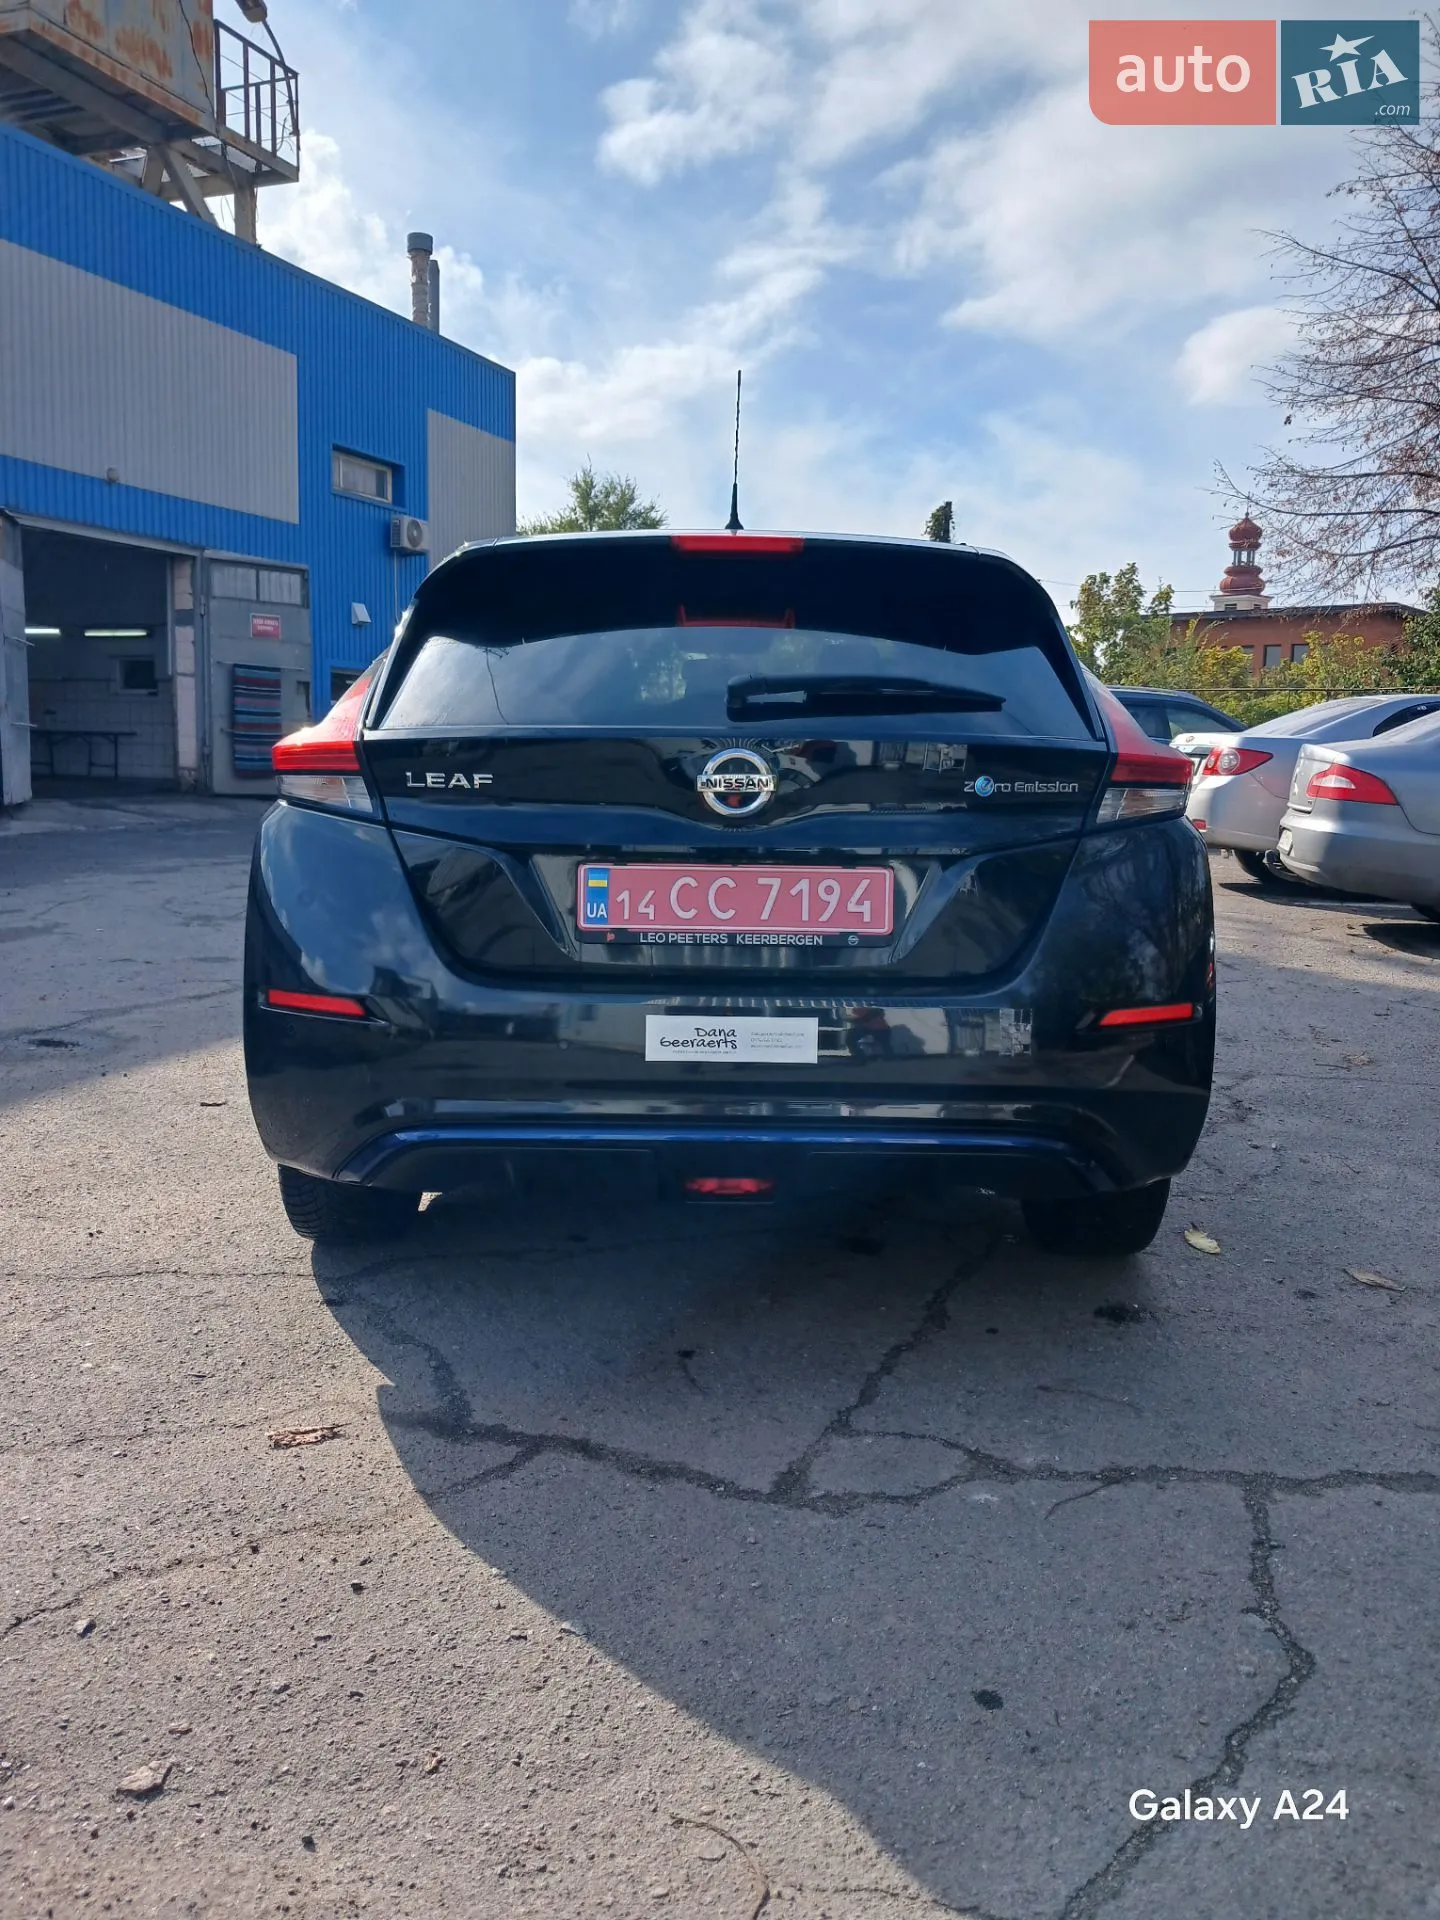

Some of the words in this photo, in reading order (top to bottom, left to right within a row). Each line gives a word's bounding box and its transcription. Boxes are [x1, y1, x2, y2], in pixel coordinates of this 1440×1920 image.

[405, 772, 494, 789] LEAF
[706, 778, 769, 789] NISSAN
[616, 890, 656, 921] 14
[669, 876, 737, 920] CC
[757, 877, 872, 922] 7194
[587, 903, 607, 919] UA
[640, 932, 666, 943] LEO
[668, 932, 728, 945] PEETERS
[736, 934, 823, 946] KEERBERGEN
[694, 1027, 737, 1040] Dana
[660, 1037, 738, 1050] Geeraerts
